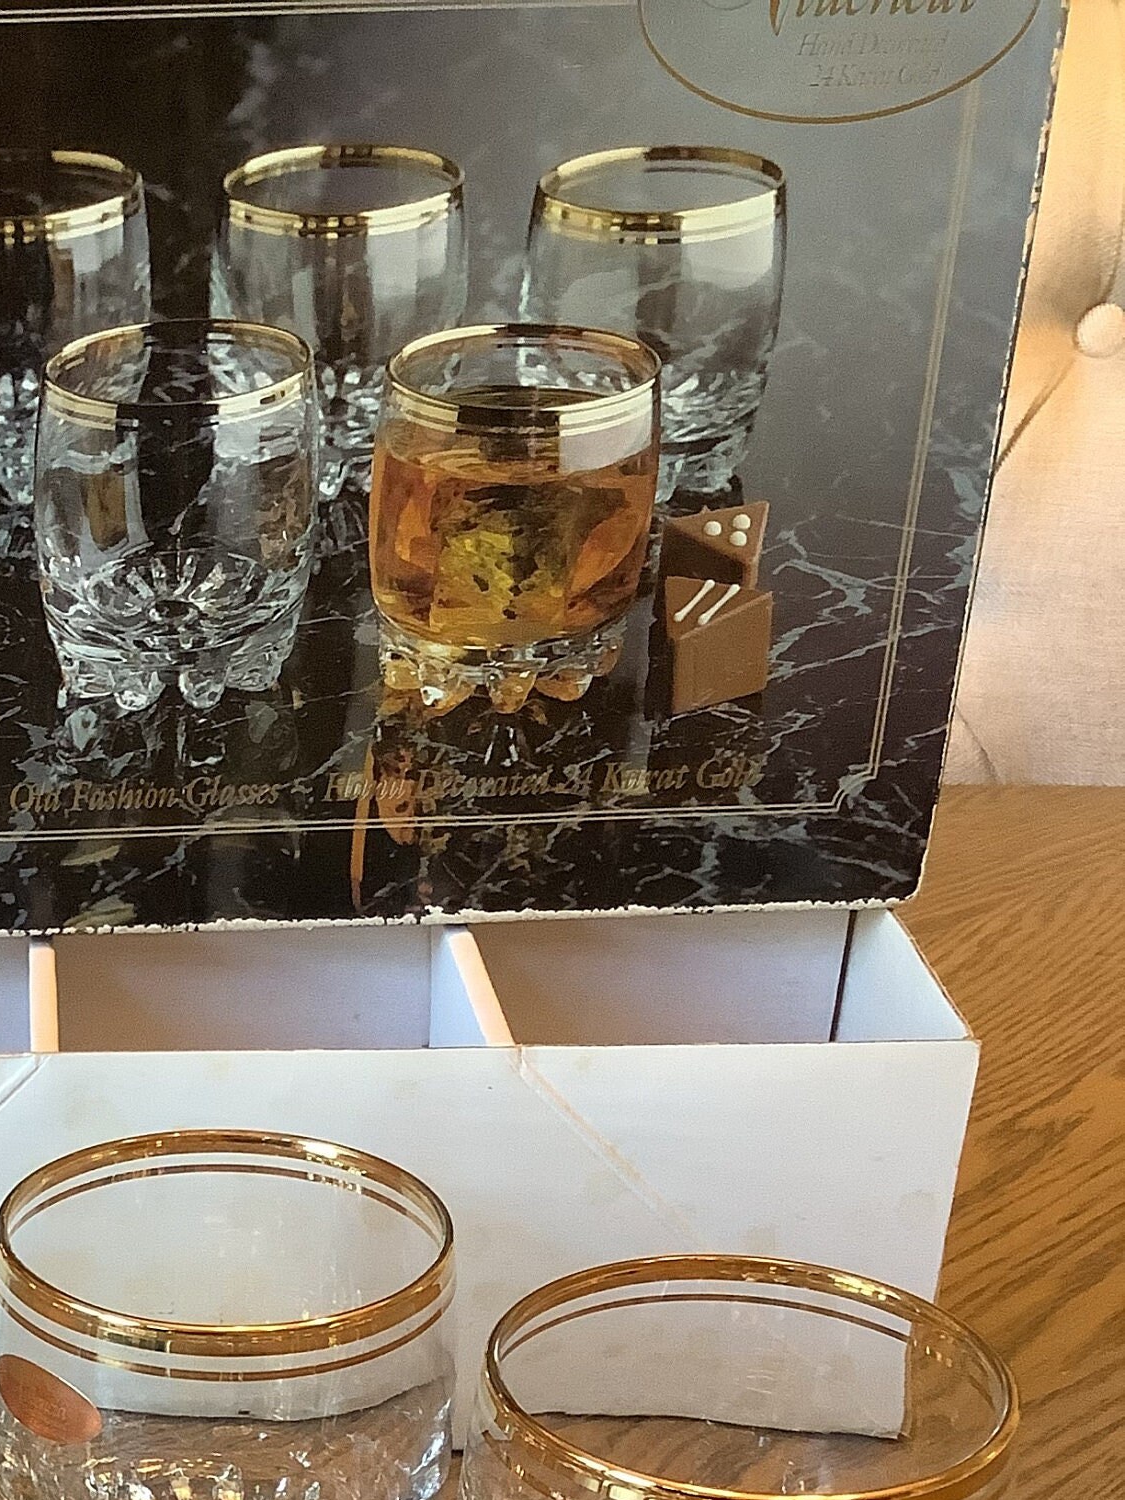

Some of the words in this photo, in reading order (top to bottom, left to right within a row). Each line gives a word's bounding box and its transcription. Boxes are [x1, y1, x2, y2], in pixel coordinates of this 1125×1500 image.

[9, 780, 63, 814] Old
[67, 777, 176, 812] Fashion
[184, 774, 280, 807] Glasses
[414, 764, 555, 800] Decorated
[599, 760, 691, 795] Karat
[695, 752, 765, 790] Gold
